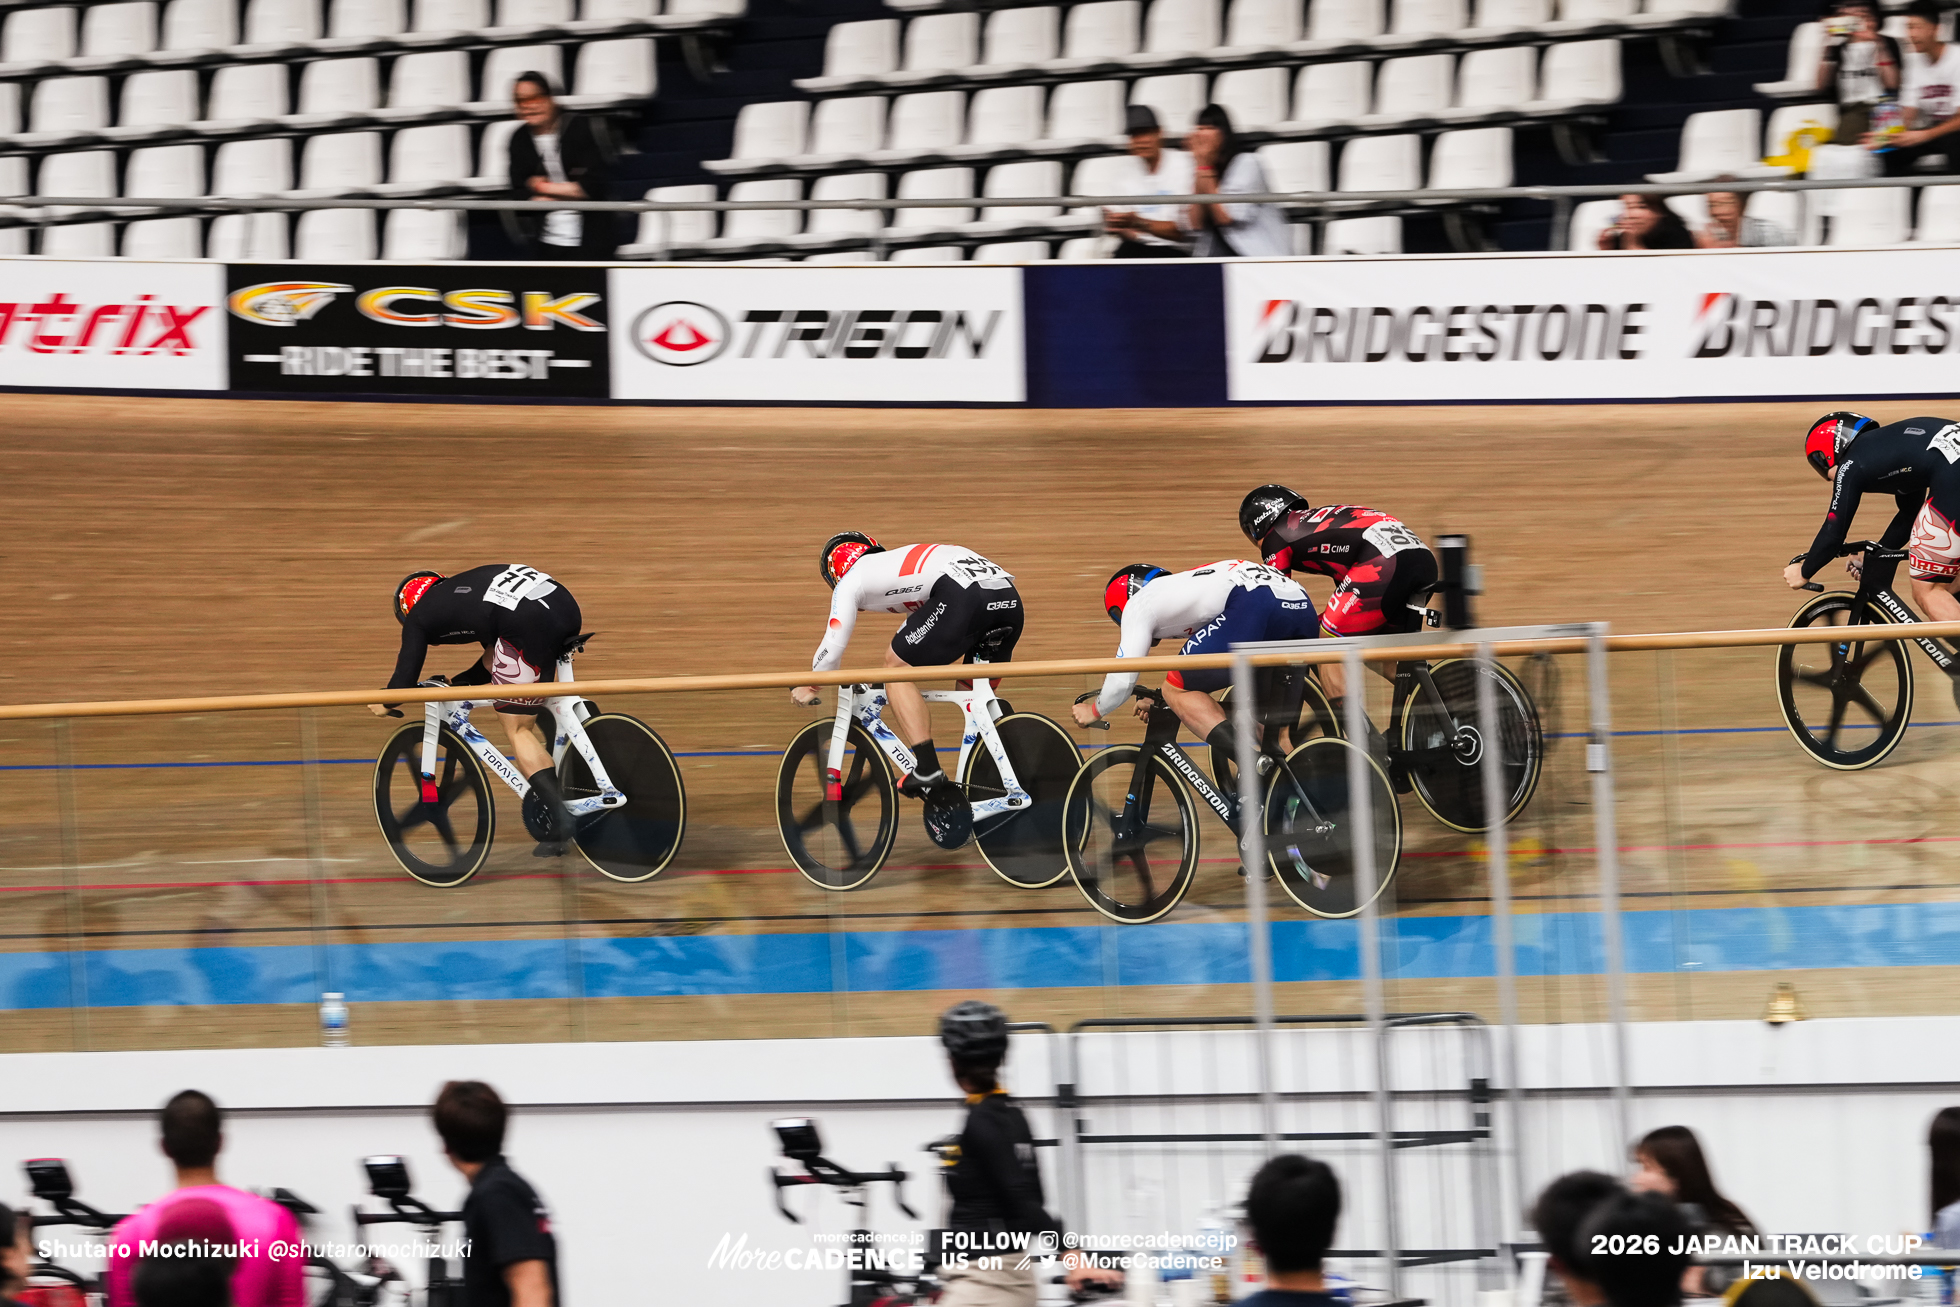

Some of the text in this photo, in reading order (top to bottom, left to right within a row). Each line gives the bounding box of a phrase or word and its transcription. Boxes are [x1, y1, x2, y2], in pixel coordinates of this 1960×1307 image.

[356, 286, 607, 332] CSK
[737, 309, 1006, 359] TRIGON
[1252, 300, 1649, 363] BRIDGESTONE
[280, 346, 554, 379] RIDE THE BEST
[1834, 420, 1847, 453] Kabuto
[841, 545, 863, 574] JAPAN
[1331, 545, 1350, 553] CIMB
[497, 571, 527, 593] 71
[1336, 575, 1352, 597] CIMB
[986, 599, 1017, 611] Q36.5
[1281, 601, 1308, 610] Q36.5
[1181, 613, 1226, 656] JAPAN
[483, 749, 524, 791] TORAYCA
[1161, 743, 1230, 820] BRIDGESTONE
